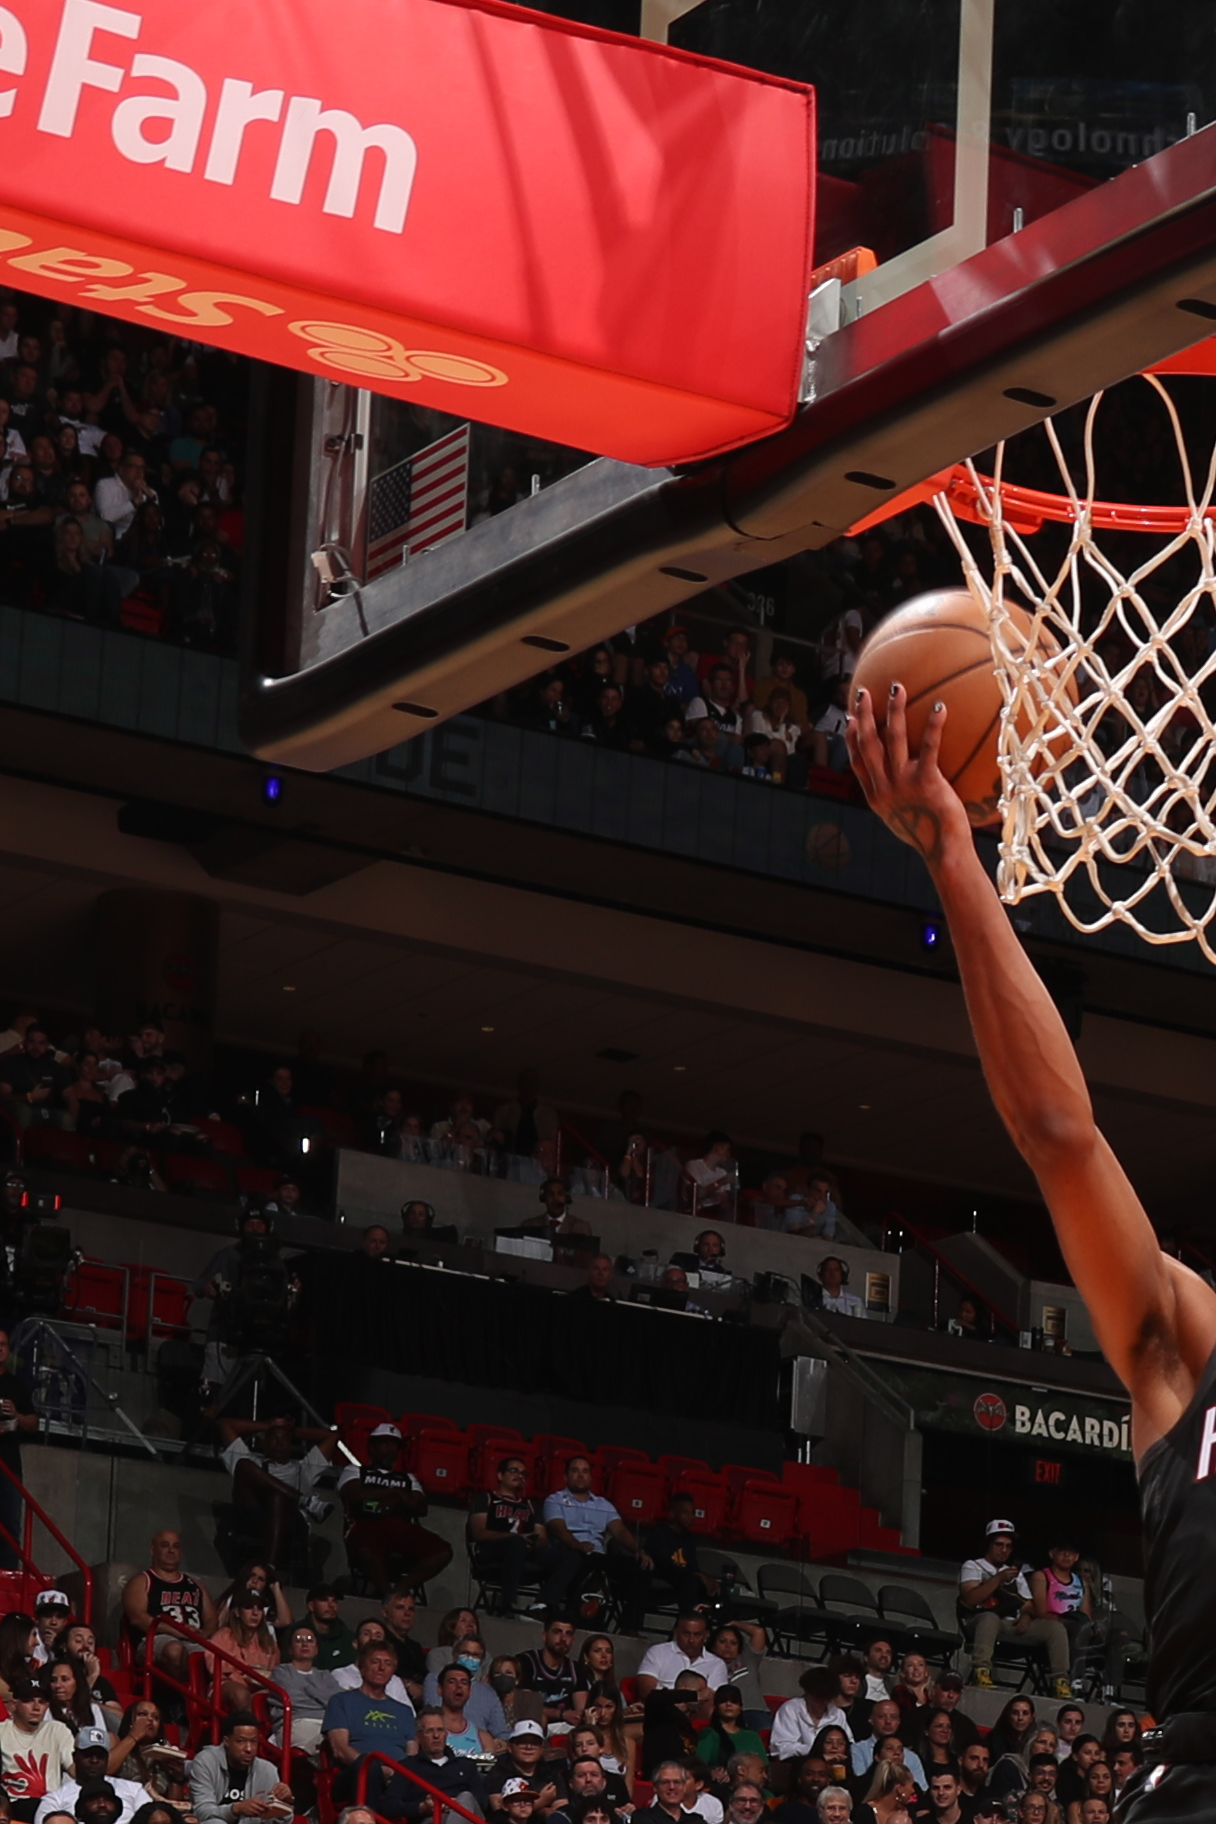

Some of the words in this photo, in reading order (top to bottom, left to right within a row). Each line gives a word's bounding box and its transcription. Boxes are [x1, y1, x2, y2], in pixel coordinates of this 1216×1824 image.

[37, 0, 417, 233] Farm
[1014, 1404, 1132, 1453] BACARDÍ
[364, 1475, 407, 1489] MIAMI
[1034, 1460, 1062, 1485] EXIT
[161, 1591, 200, 1606] HEAT
